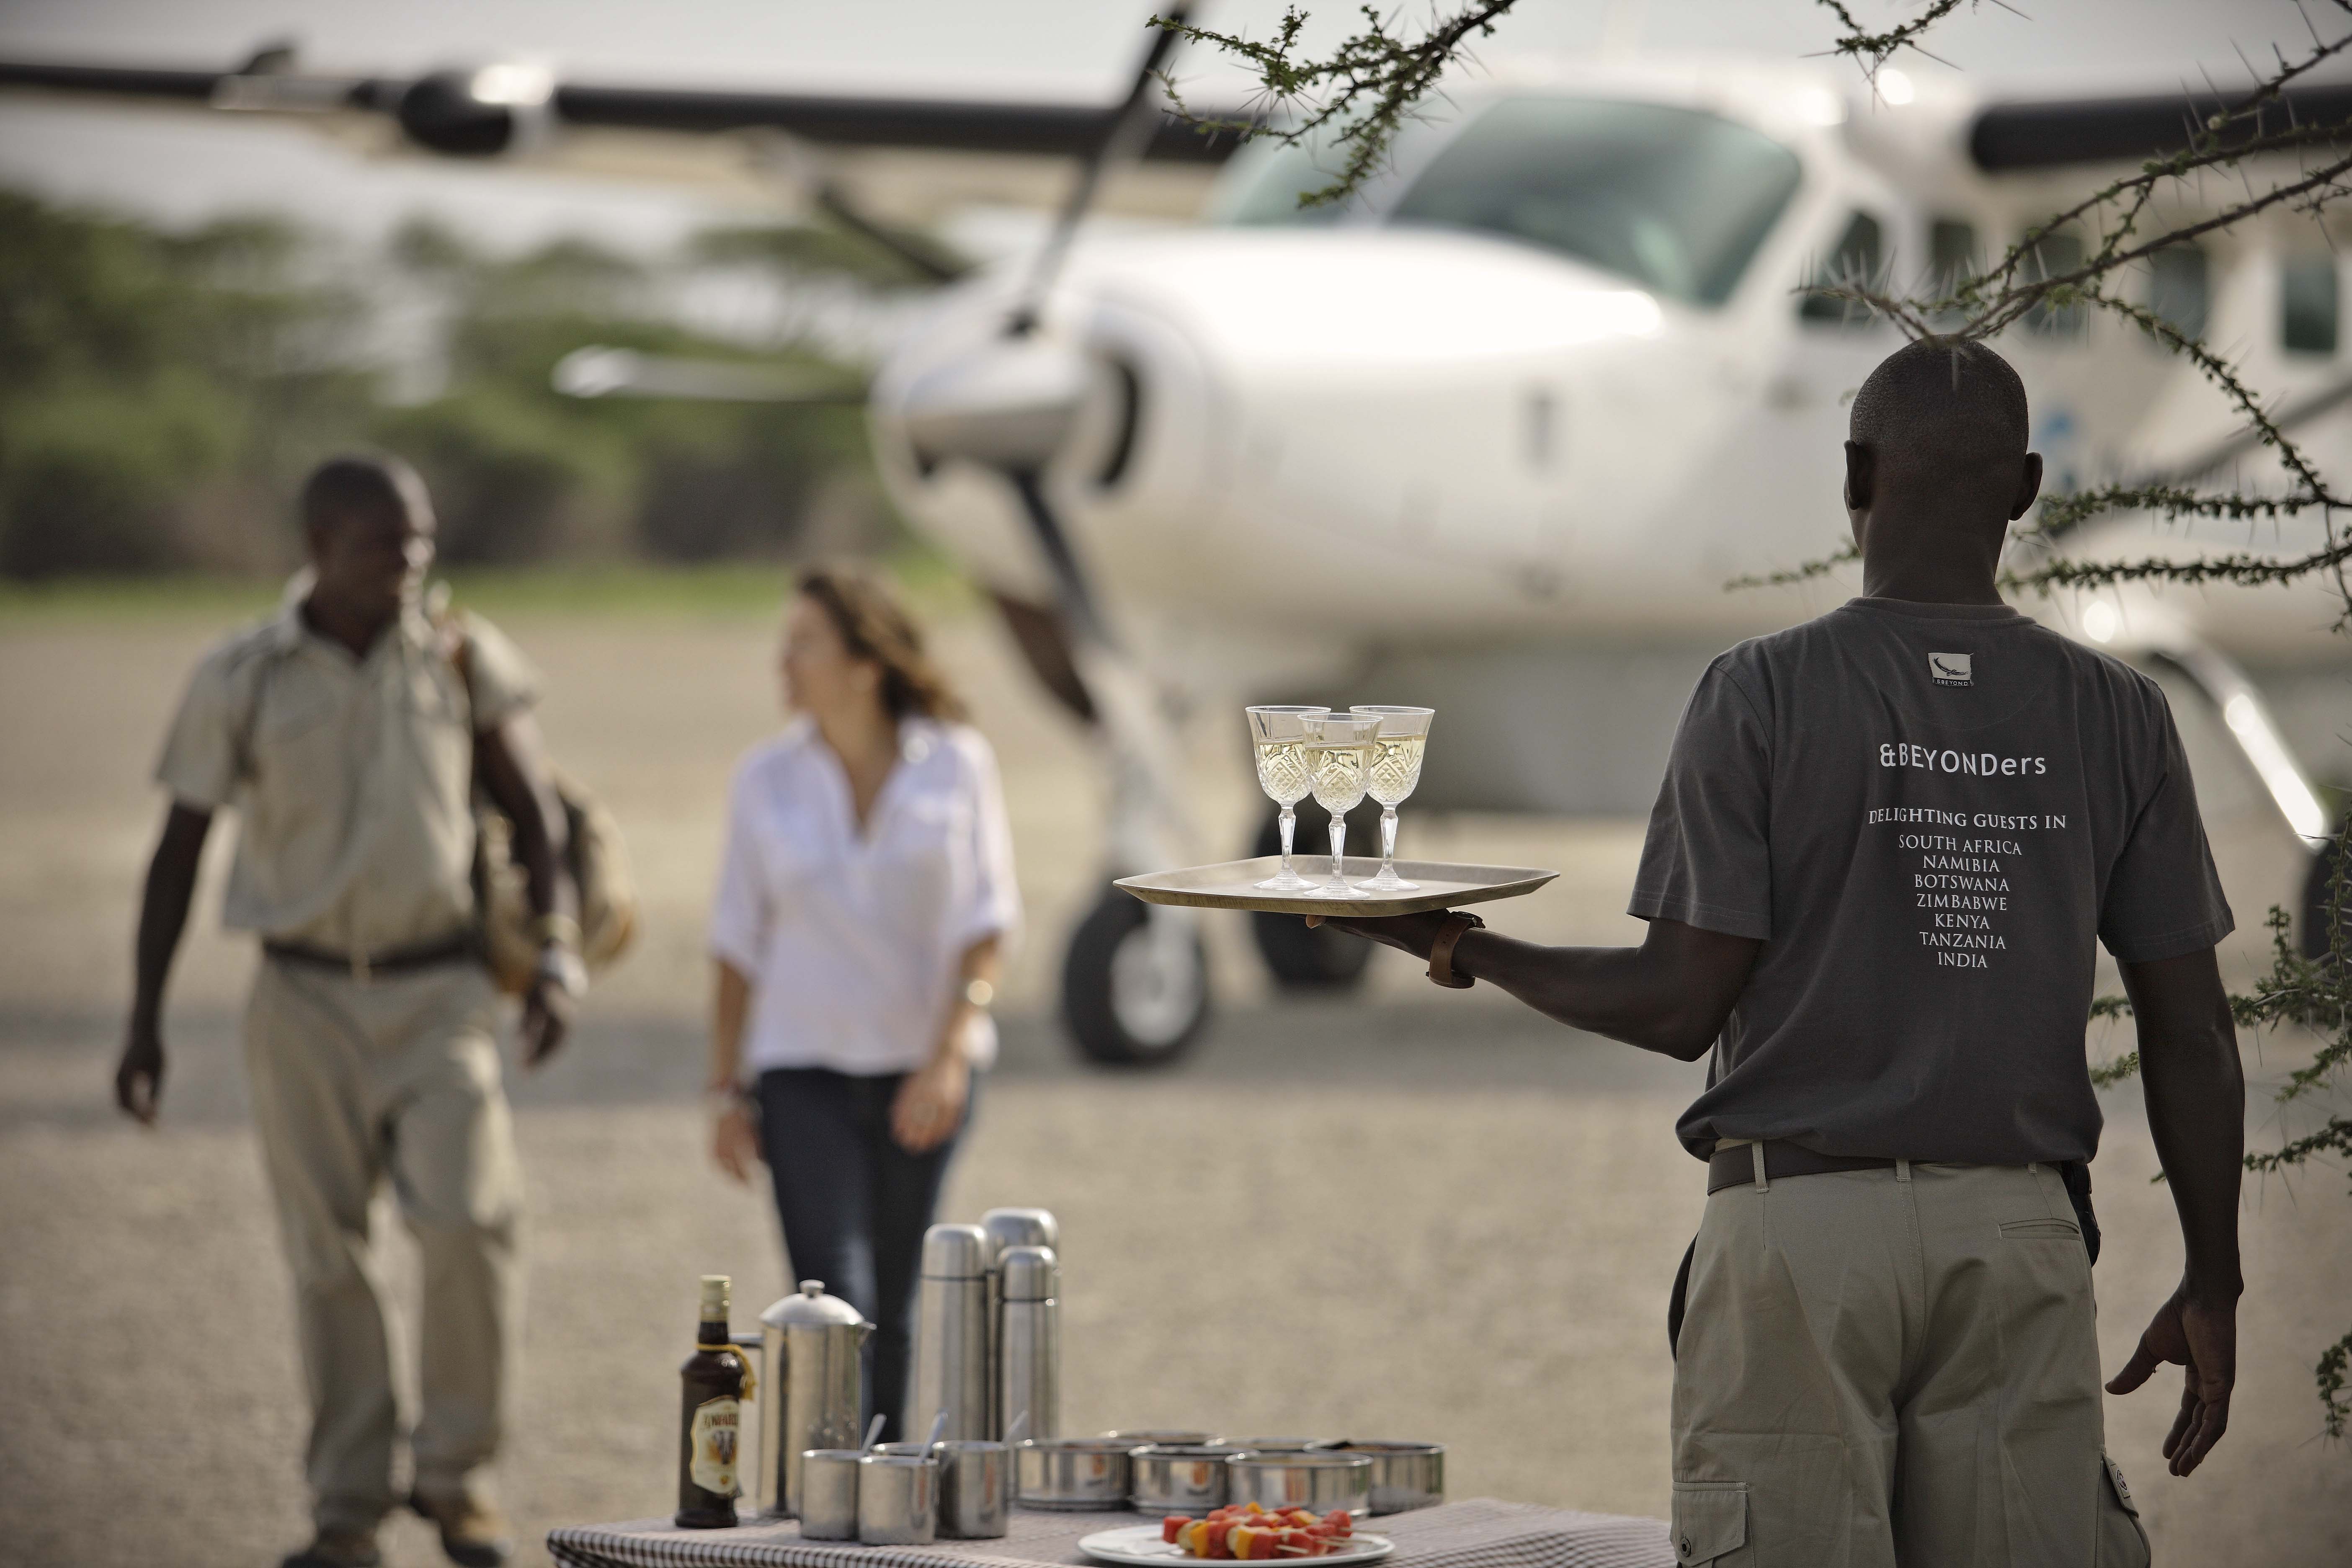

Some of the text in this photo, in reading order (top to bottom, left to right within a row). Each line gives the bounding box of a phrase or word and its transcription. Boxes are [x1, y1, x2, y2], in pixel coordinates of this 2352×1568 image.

[1880, 743, 2046, 776] &BEYONDers
[1868, 807, 2066, 830] DELIGHTING GUESTS IN
[1899, 835, 2023, 856] SOUTH AFRICA
[1923, 855, 2000, 872] NAMIBIA
[1914, 874, 2010, 892] BOTSWANA
[1916, 893, 2007, 911] ZIMBABWE
[1934, 913, 1990, 929] KENYA
[1919, 931, 2006, 949] TANZANIA
[1937, 952, 1988, 968] INDIA
